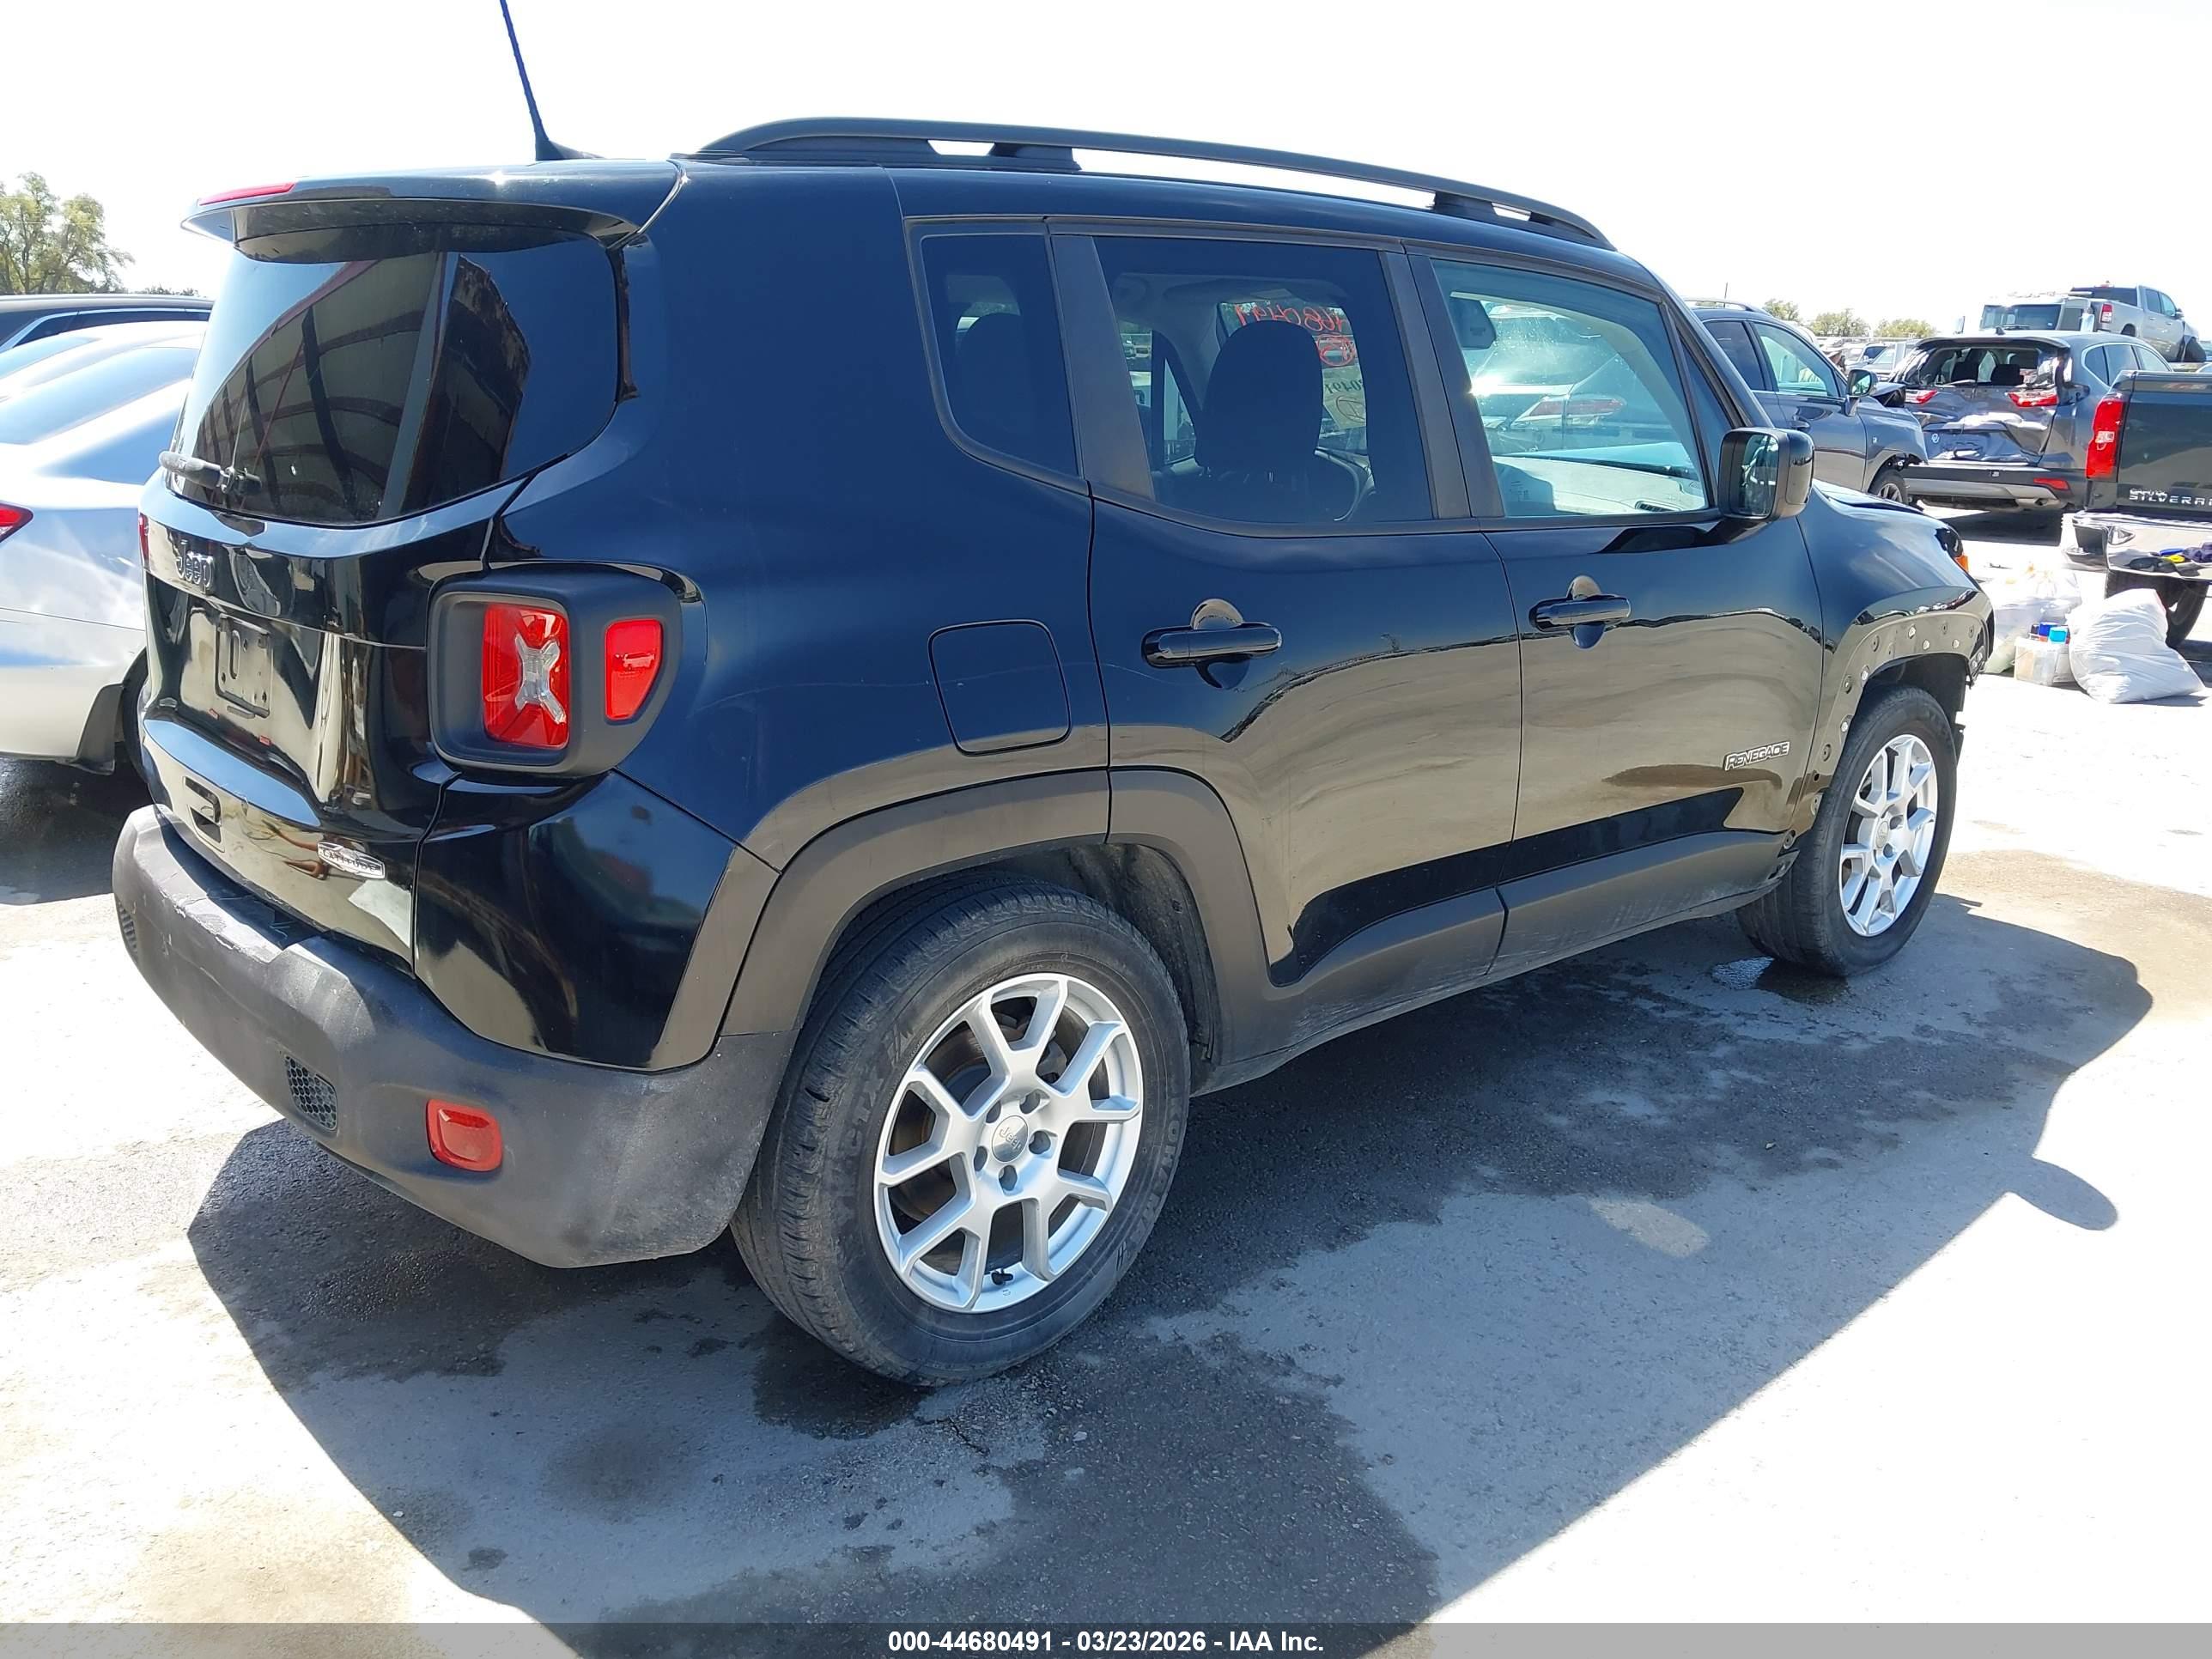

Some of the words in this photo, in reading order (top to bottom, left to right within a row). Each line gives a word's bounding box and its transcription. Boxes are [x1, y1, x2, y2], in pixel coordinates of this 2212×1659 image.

[175, 539, 215, 594] Jeep
[1723, 741, 1790, 771] RENEGADE
[321, 848, 378, 872] LATITUDE
[1000, 1127, 1022, 1151] Jeep
